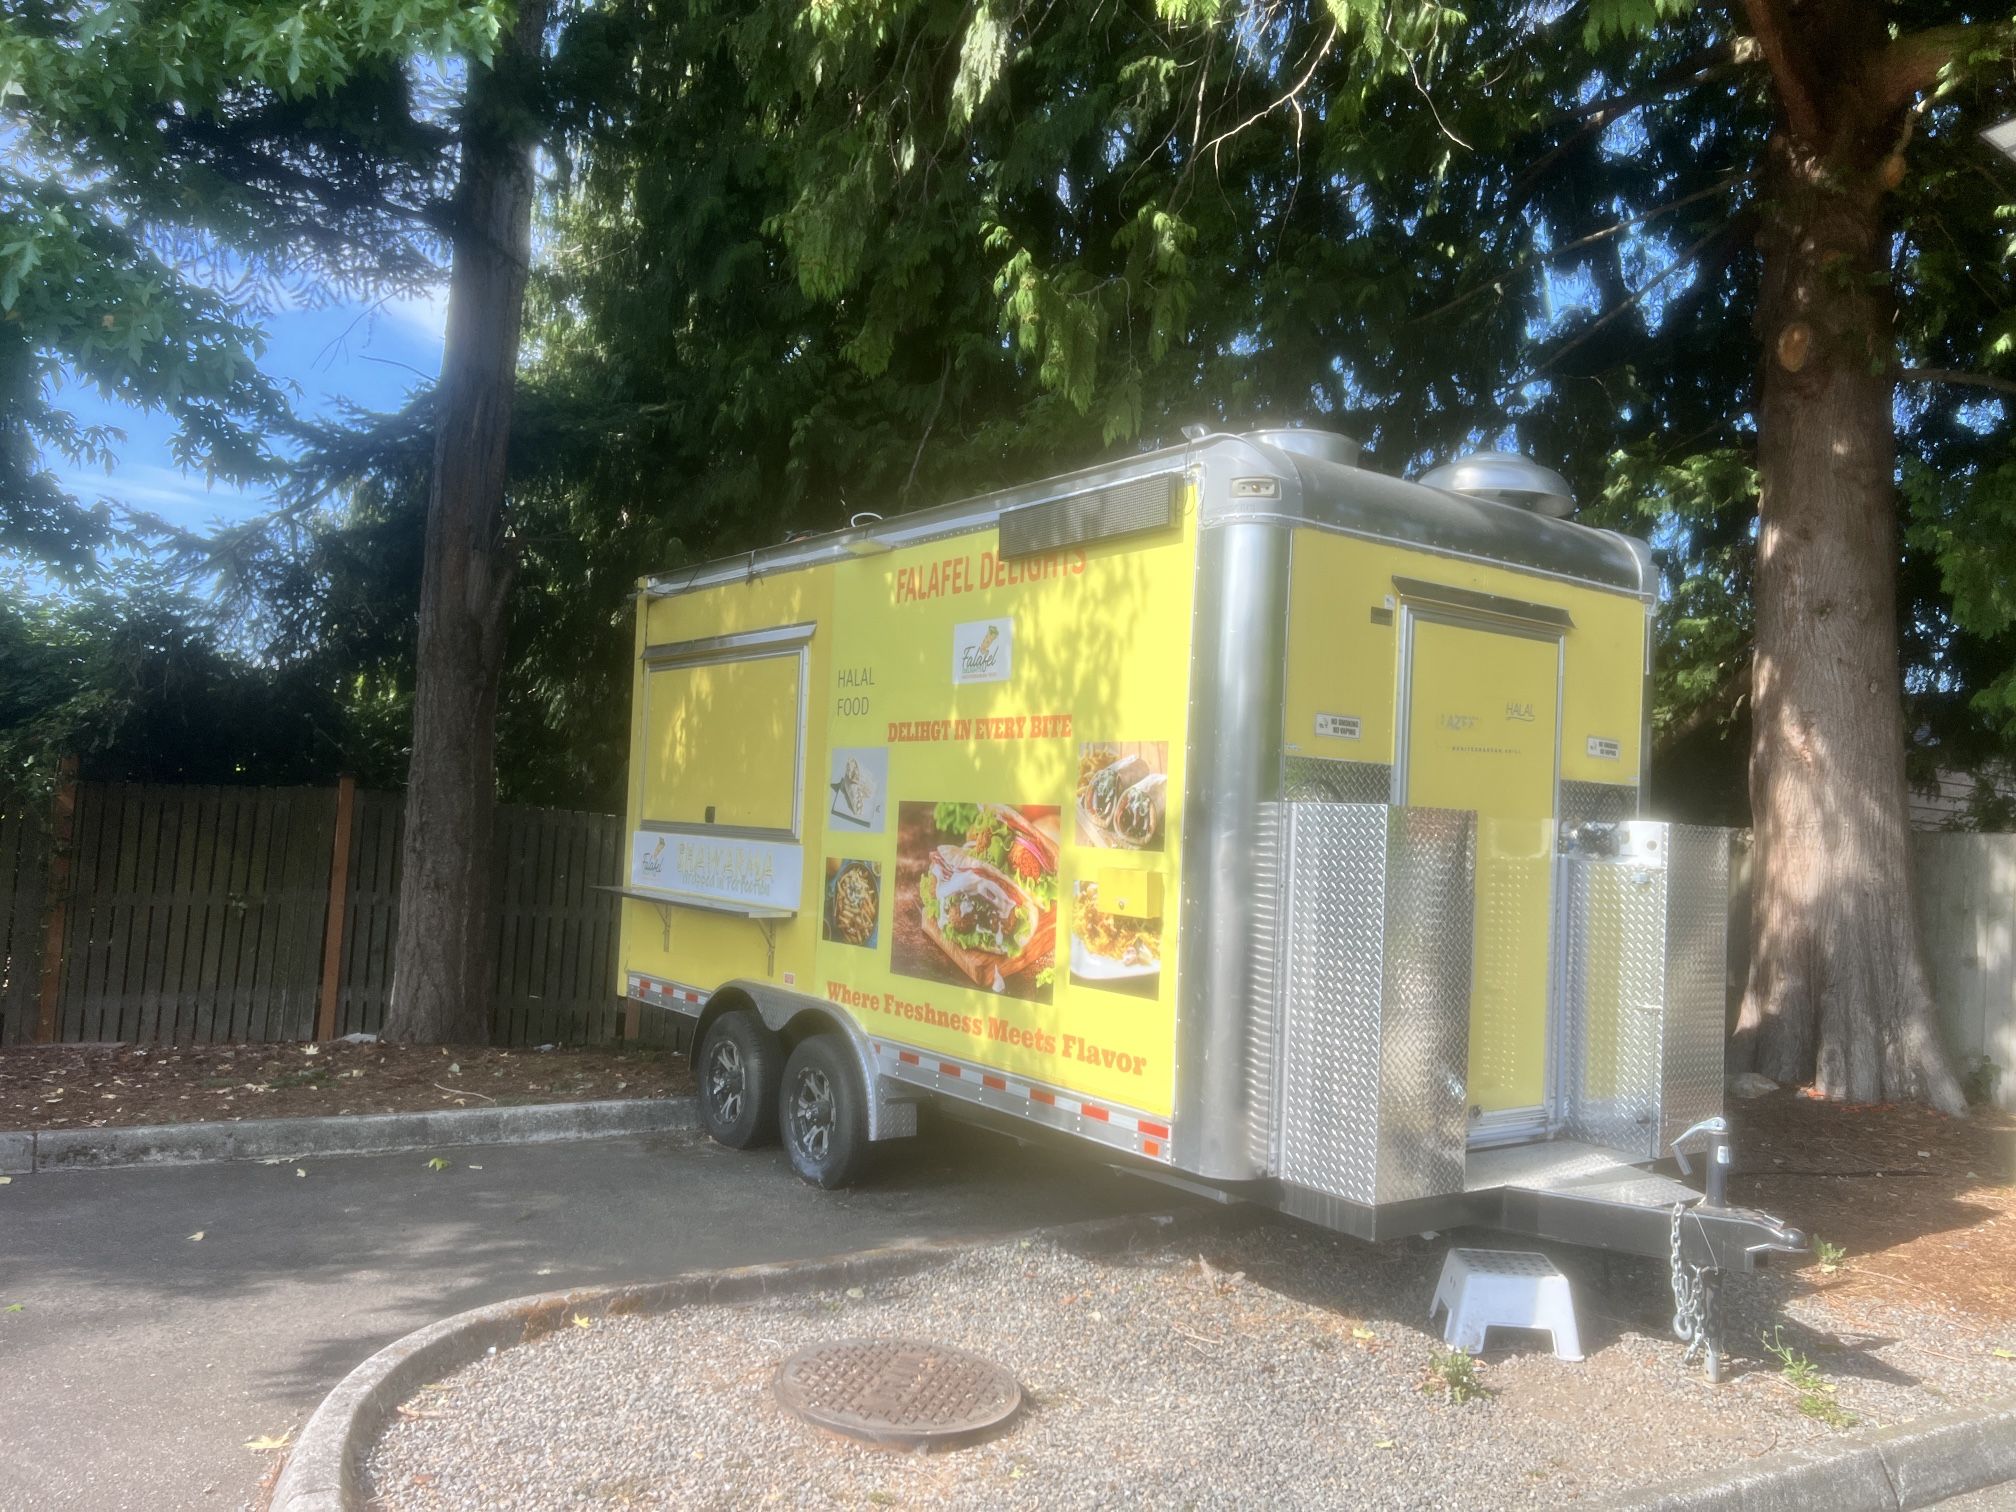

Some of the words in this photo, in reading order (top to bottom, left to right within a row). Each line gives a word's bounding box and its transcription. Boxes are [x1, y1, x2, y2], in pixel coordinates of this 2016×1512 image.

[896, 556, 974, 603] FALAFEL
[962, 645, 999, 672] Falafel
[837, 667, 875, 688] HALAL
[837, 696, 869, 717] FOOD
[1505, 701, 1535, 717] HALAL
[888, 720, 951, 742] DELIHGT
[954, 719, 972, 740] IN
[975, 717, 1026, 740] EVERY
[1030, 715, 1072, 738] BITE
[827, 981, 880, 1011] Where
[884, 993, 983, 1036] Freshness
[988, 1016, 1056, 1054] Meets
[1062, 1034, 1147, 1075] Flavor
